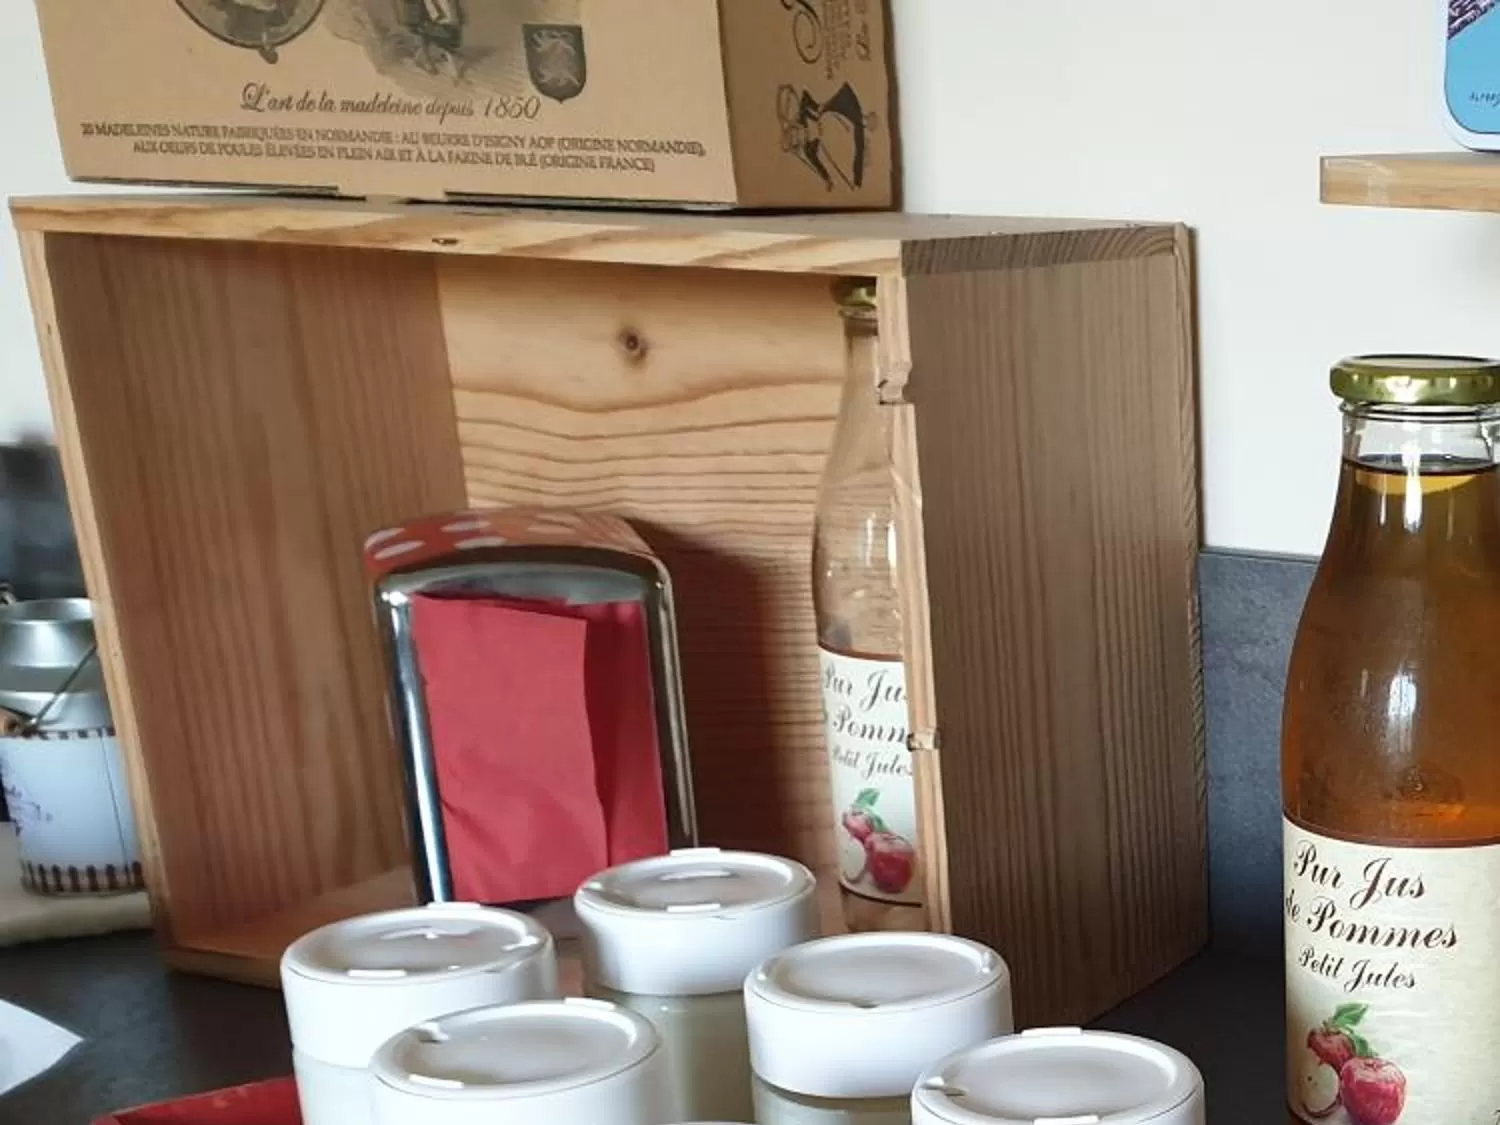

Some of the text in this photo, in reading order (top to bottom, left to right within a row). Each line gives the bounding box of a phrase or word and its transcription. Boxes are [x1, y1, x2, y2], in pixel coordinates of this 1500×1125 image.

[295, 90, 316, 112] de
[318, 90, 337, 112] la
[340, 91, 423, 116] madeleine
[425, 96, 474, 125] depuis
[484, 95, 542, 120] 1850
[95, 122, 170, 138] MADELEINES
[401, 131, 419, 145] AU
[421, 132, 470, 147] BEURRE
[529, 136, 555, 150] AOP
[859, 667, 907, 713] Ju
[833, 704, 907, 743] Pomm
[1293, 838, 1427, 910] Pur Jus
[1305, 894, 1459, 950] Pommes
[1298, 945, 1417, 993] Petit Jules
